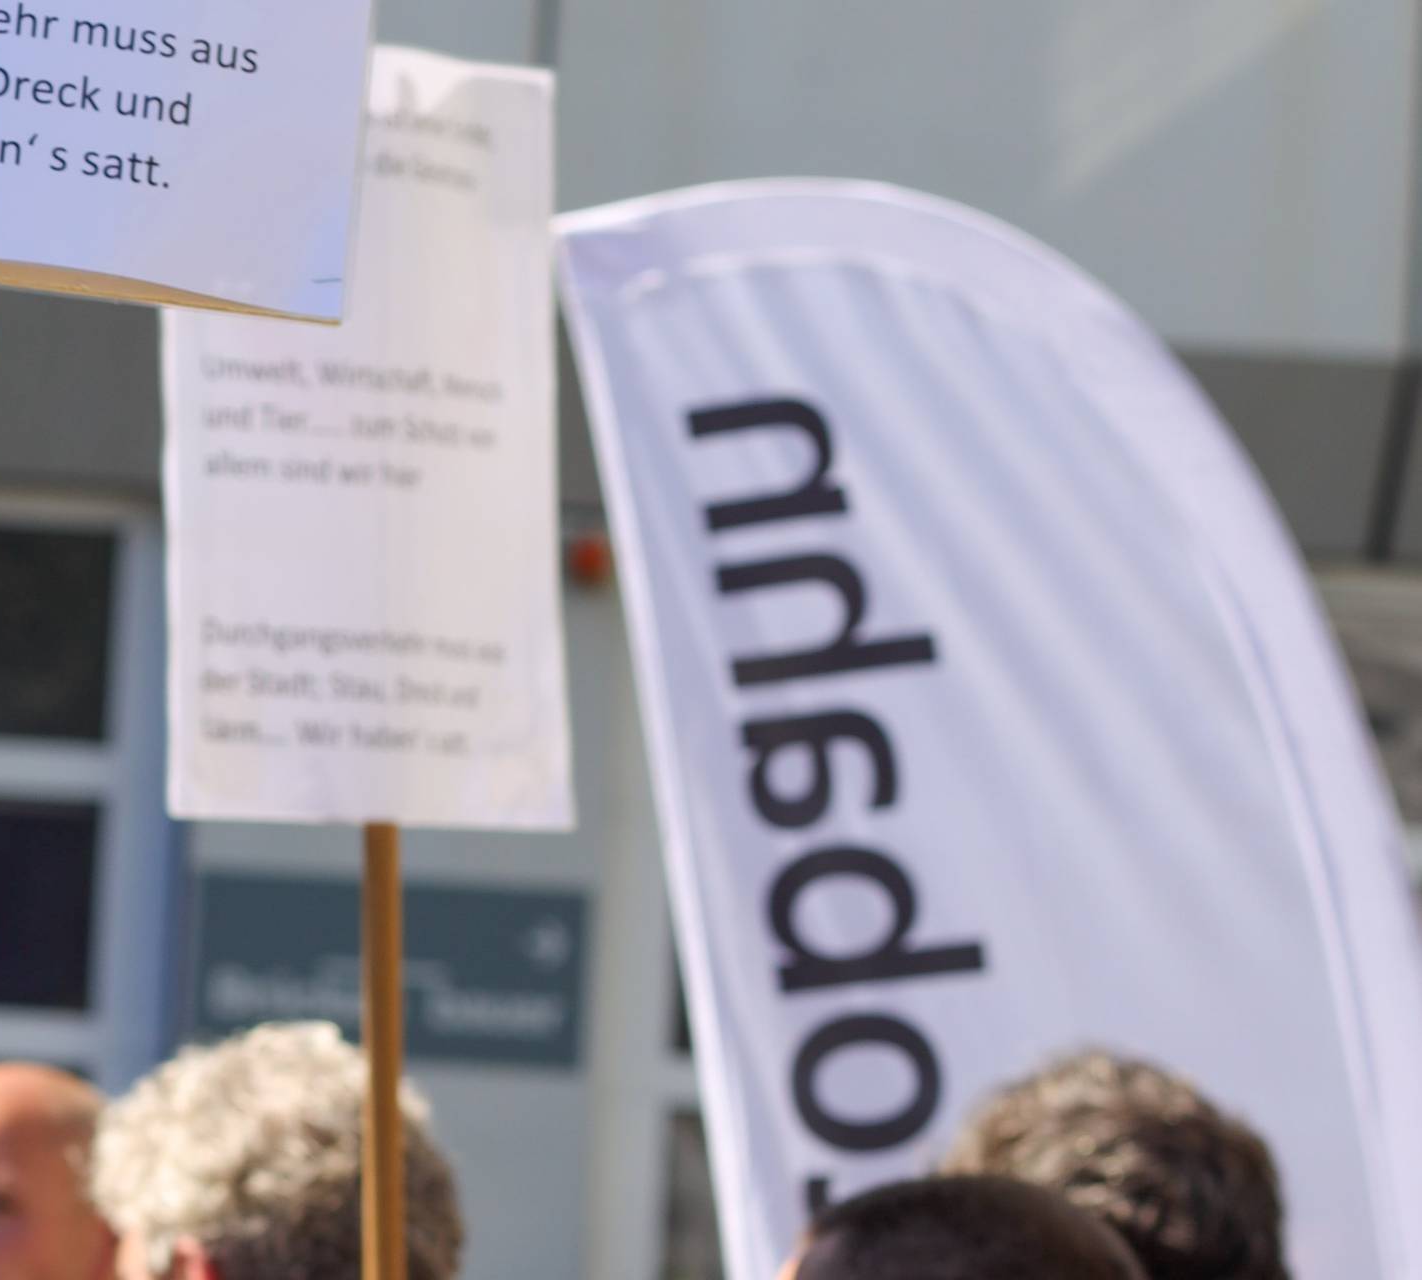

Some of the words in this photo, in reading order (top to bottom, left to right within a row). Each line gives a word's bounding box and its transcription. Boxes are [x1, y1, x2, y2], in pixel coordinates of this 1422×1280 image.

[72, 19, 178, 58] muss
[191, 37, 258, 74] aus
[115, 92, 192, 126] und
[49, 146, 69, 172] s
[81, 149, 170, 189] satt.
